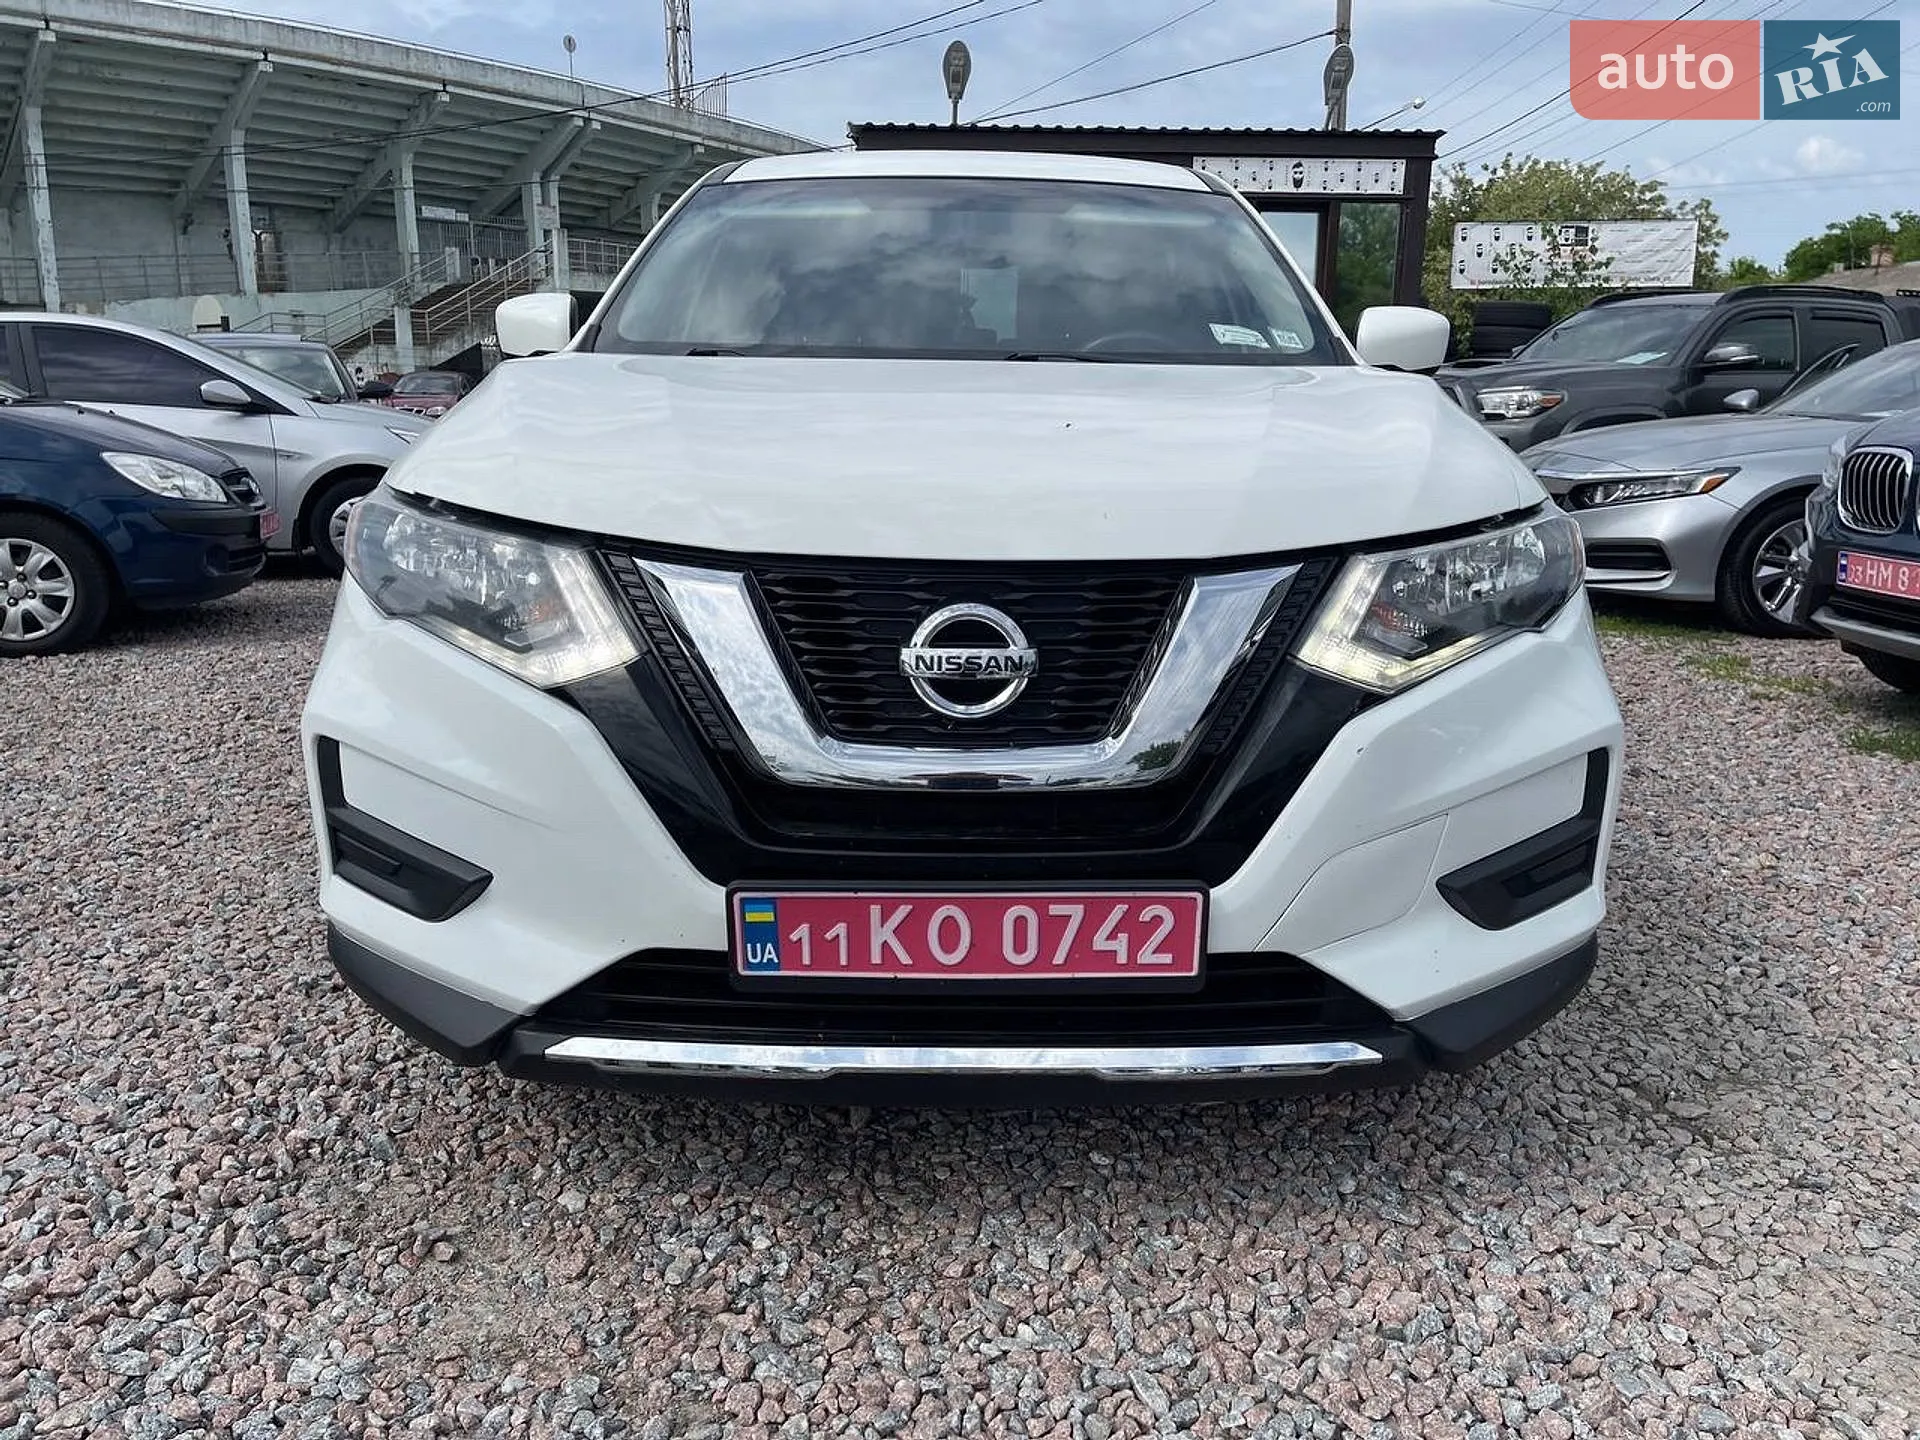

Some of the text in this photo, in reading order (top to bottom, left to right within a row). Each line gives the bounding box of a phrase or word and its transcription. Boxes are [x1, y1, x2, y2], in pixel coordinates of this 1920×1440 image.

[914, 654, 1023, 672] NISSAN
[1002, 904, 1176, 966] 0742
[746, 942, 779, 964] UA
